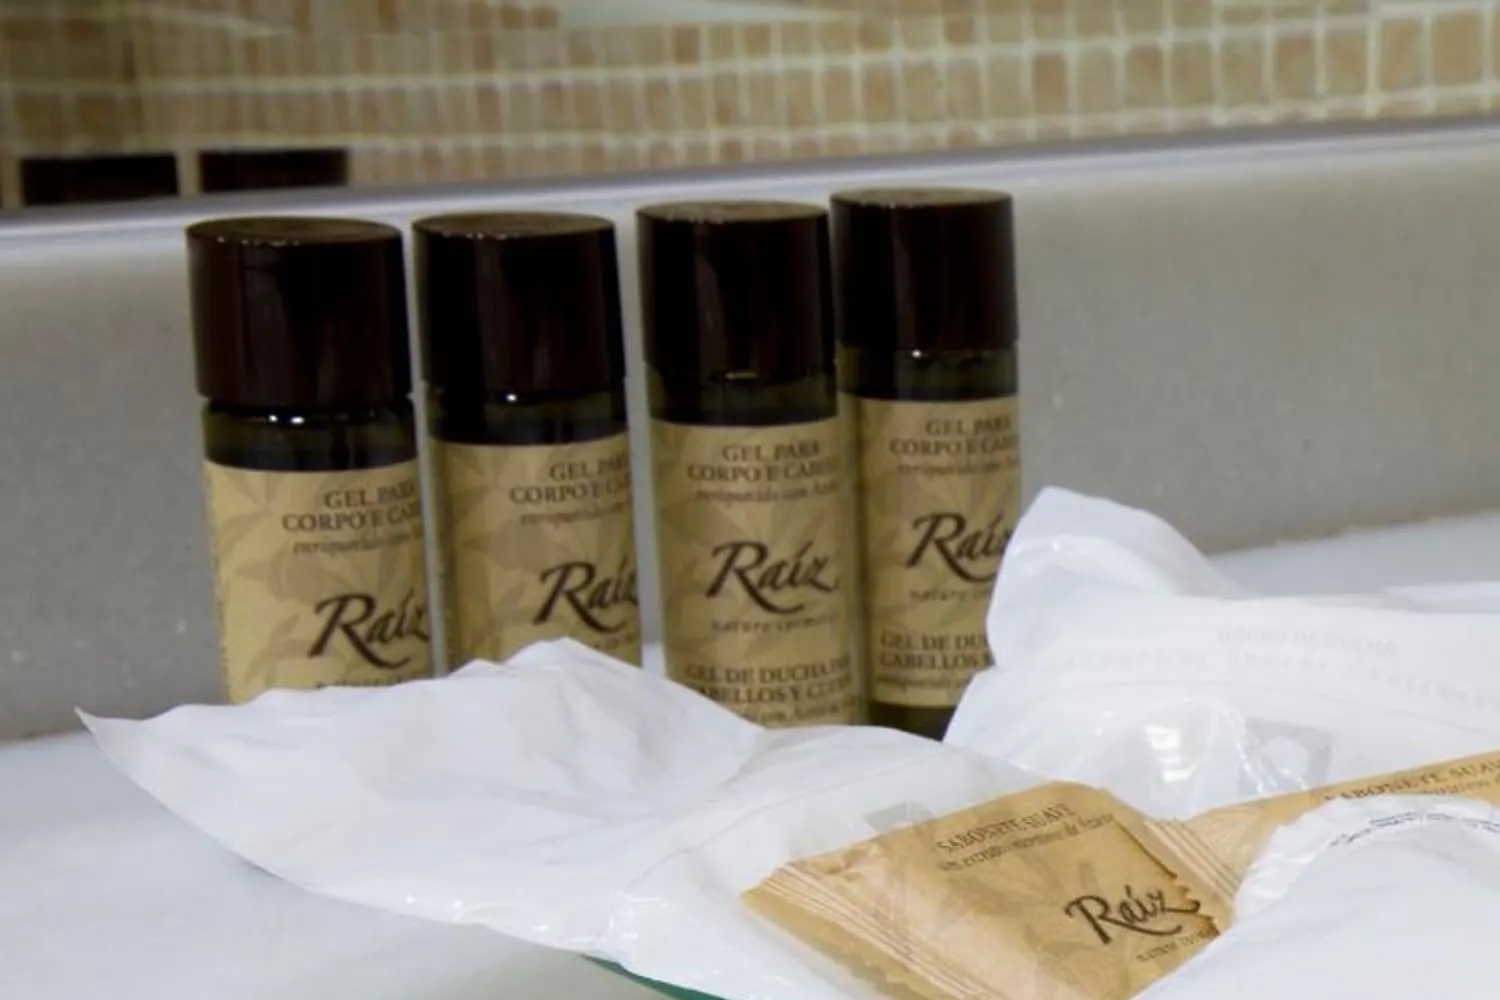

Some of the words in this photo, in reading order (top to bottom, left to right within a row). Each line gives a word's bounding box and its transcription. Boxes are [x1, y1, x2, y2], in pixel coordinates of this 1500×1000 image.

[925, 419, 966, 435] GEL
[722, 444, 765, 462] GEL
[889, 438, 962, 456] CORPO
[549, 461, 590, 480] GEL
[687, 462, 761, 481] CORPO
[324, 488, 368, 510] GEL
[509, 482, 587, 505] CORPO
[281, 510, 367, 533] CORPO
[705, 539, 840, 614] Raíz
[696, 682, 787, 704] ABELLOS
[1064, 883, 1201, 944] Raíz
